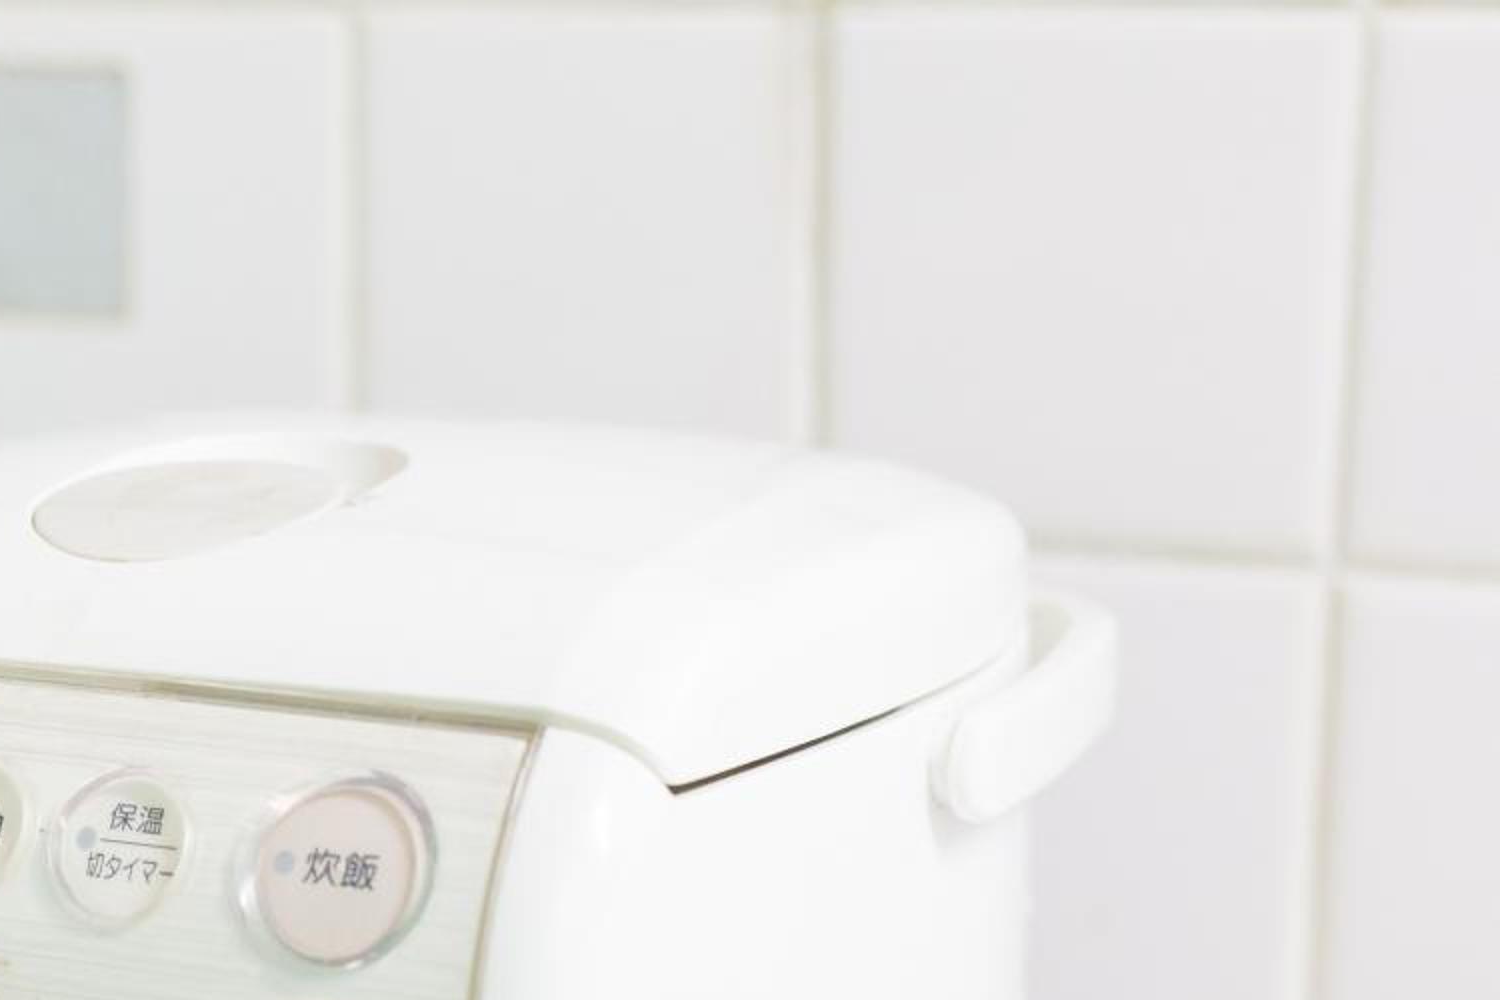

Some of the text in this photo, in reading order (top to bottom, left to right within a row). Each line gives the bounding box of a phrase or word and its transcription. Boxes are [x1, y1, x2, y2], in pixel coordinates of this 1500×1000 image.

[109, 802, 165, 835] 保温
[86, 851, 174, 885] 切タイマー
[303, 848, 381, 891] 炊飯
